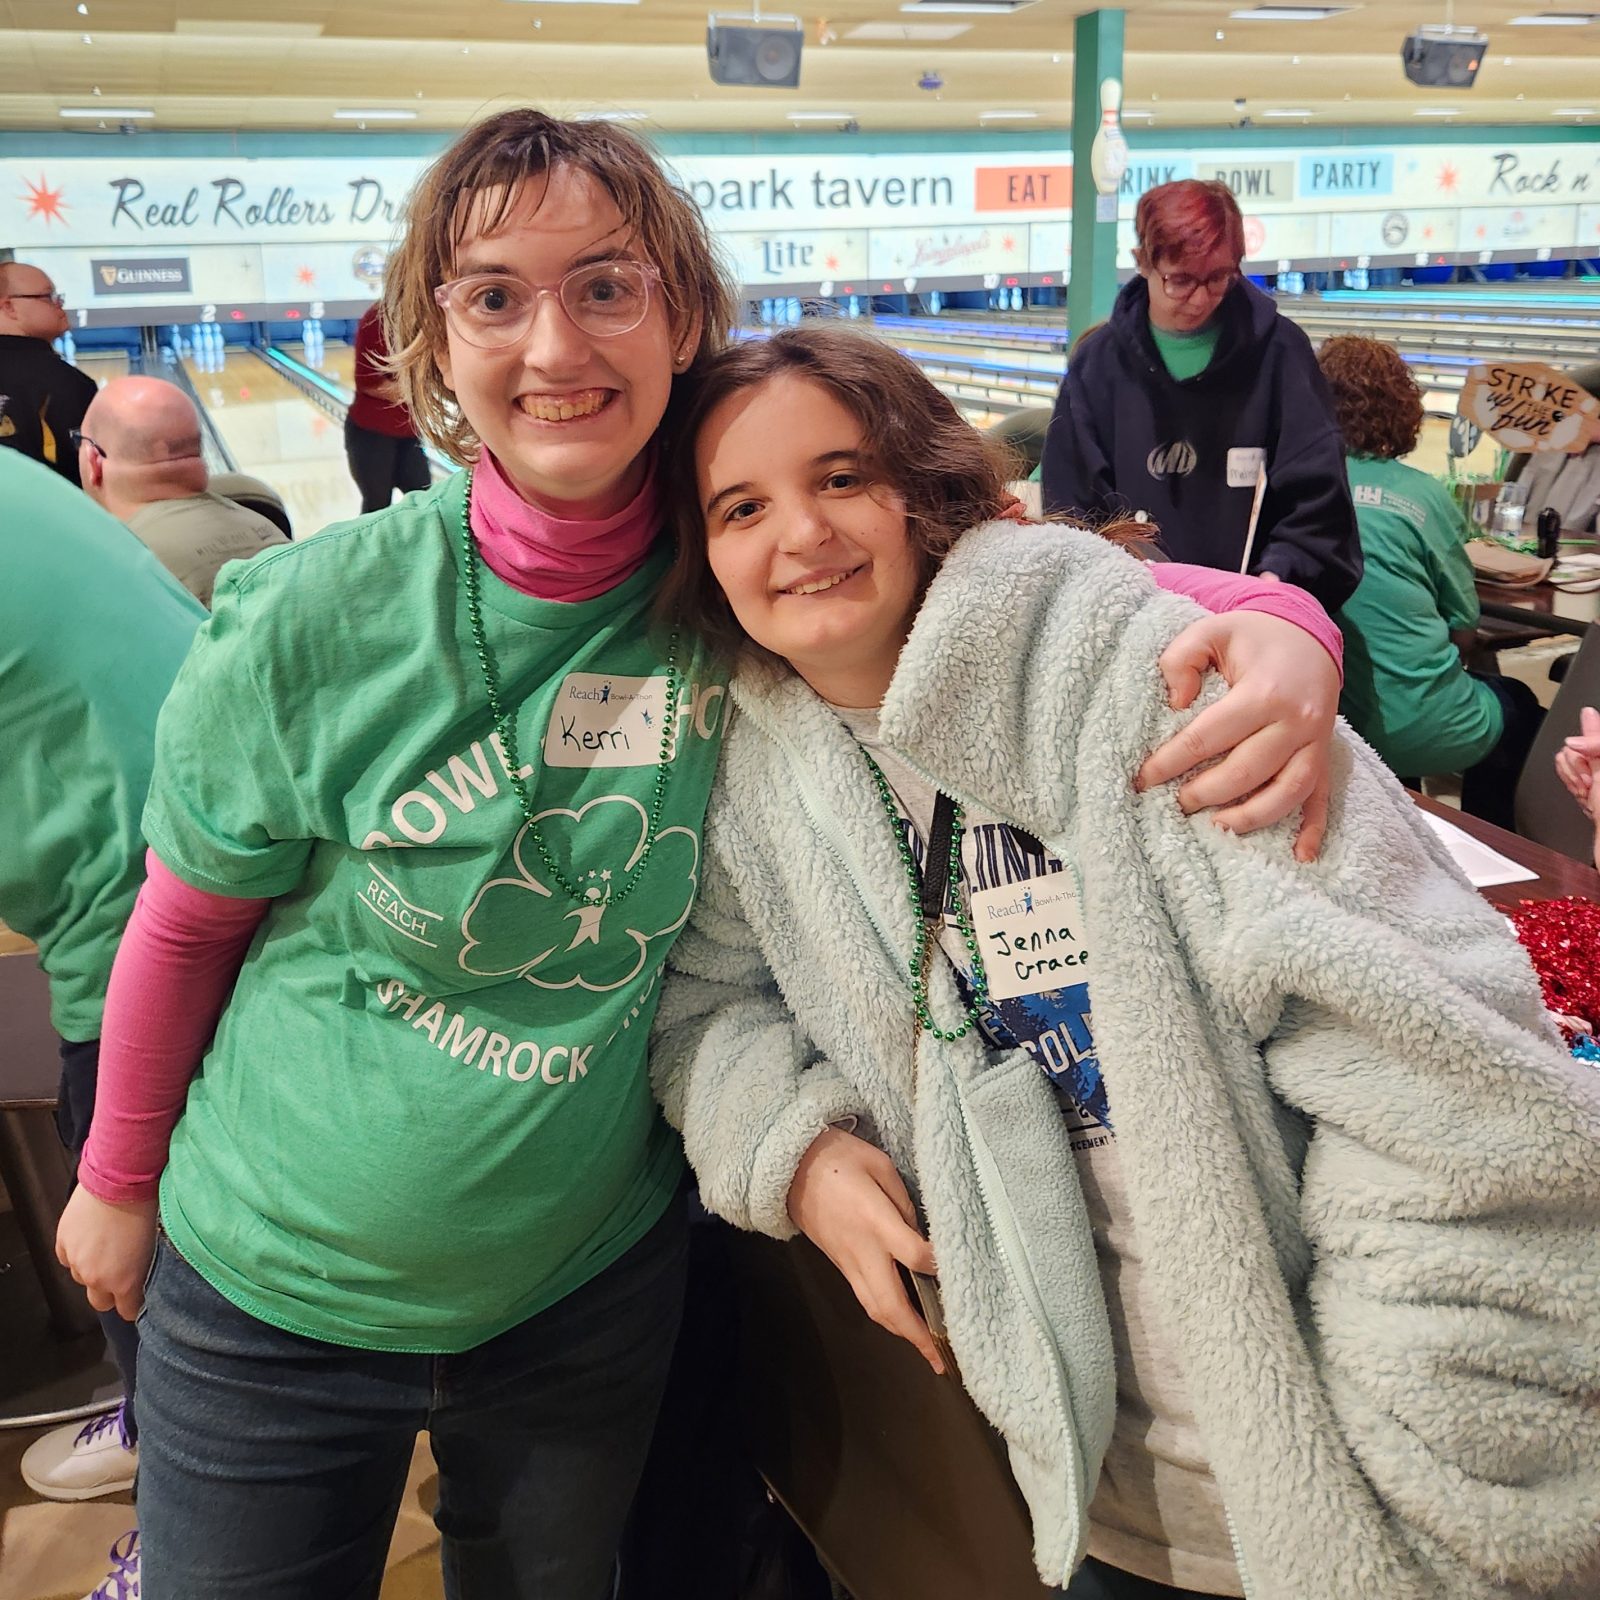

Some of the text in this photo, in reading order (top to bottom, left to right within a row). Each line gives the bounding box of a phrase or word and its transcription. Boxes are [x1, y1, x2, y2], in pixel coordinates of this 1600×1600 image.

[1007, 174, 1051, 203] EAT
[1119, 166, 1177, 194] RINK
[1312, 160, 1381, 190] PARTY
[1489, 153, 1560, 195] Rock
[108, 177, 402, 230] Real Rollers Dr
[691, 169, 953, 211] park tavern
[762, 240, 814, 275] Lite
[116, 266, 184, 284] GUINNESS
[76, 309, 88, 327] 1
[200, 304, 217, 323] 2
[569, 685, 653, 701] Reach Bowl-A-Thon
[561, 715, 630, 751] Kerri
[367, 880, 428, 936] REACH
[987, 898, 1024, 920] Reach
[990, 928, 1076, 956] Jenna
[1015, 950, 1089, 980] Grace
[377, 979, 594, 1084] SHAMROCK
